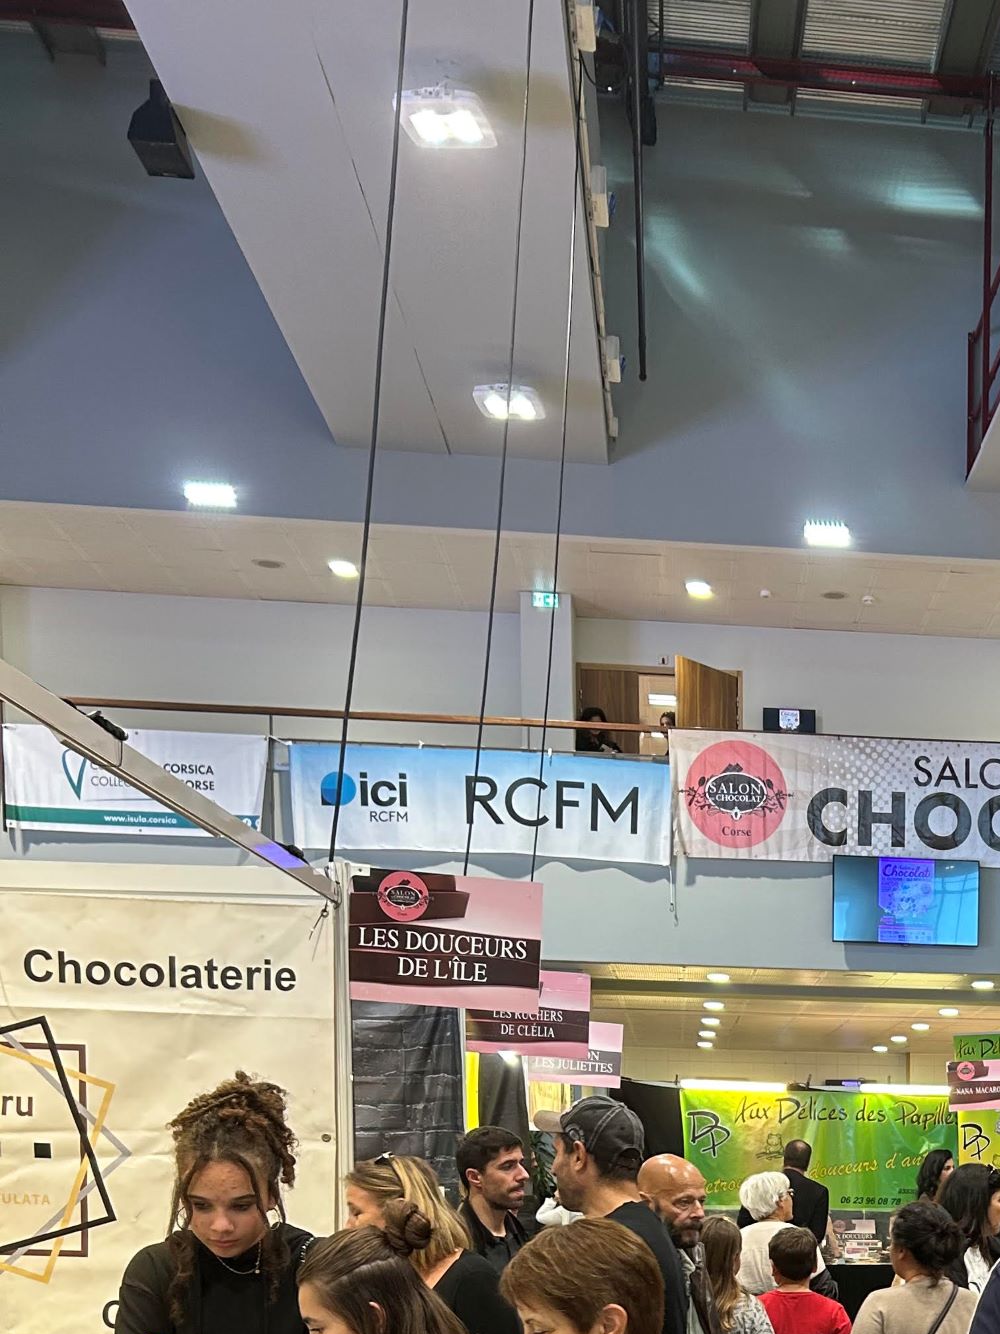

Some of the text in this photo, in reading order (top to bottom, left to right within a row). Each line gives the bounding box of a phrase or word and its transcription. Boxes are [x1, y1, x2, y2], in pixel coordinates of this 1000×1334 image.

[185, 780, 215, 791] ORSE
[359, 771, 408, 807] ici
[709, 782, 761, 795] SALON
[465, 774, 639, 835] RCFM
[716, 794, 761, 803] CHOCOLAT
[104, 815, 177, 824] www.isula.corsica
[369, 810, 408, 823] RCFM
[721, 826, 752, 837] Corse
[882, 863, 931, 878] Chocolat
[358, 926, 527, 960] LES DOUCEURS
[24, 948, 297, 992] Chocolaterie
[398, 955, 488, 983] DE L'ÎLE
[514, 1009, 563, 1023] RUCHERS
[500, 1022, 555, 1038] DE CLÉLIA
[556, 1060, 613, 1074] JULIETTES
[956, 1087, 973, 1095] NANA
[774, 1096, 848, 1124] Délices
[855, 1099, 886, 1122] des
[809, 1160, 877, 1179] douceurs
[840, 1196, 851, 1204] 06
[853, 1196, 864, 1204] 23
